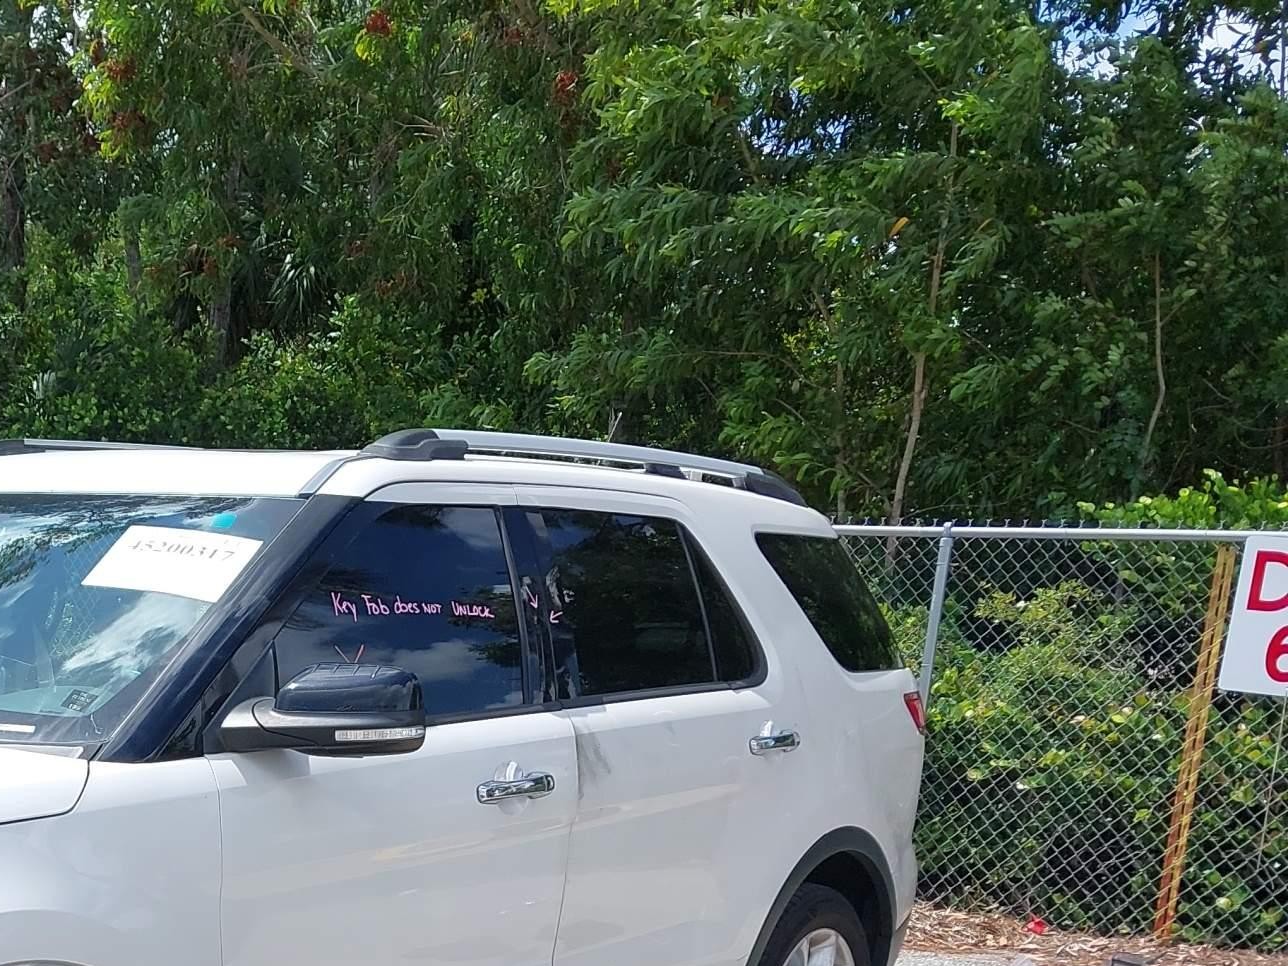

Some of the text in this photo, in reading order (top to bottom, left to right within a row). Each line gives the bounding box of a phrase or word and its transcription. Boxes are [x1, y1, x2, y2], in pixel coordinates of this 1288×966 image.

[128, 539, 236, 562] 45200317
[331, 592, 495, 623] Key Fob does NOT UNLOCK
